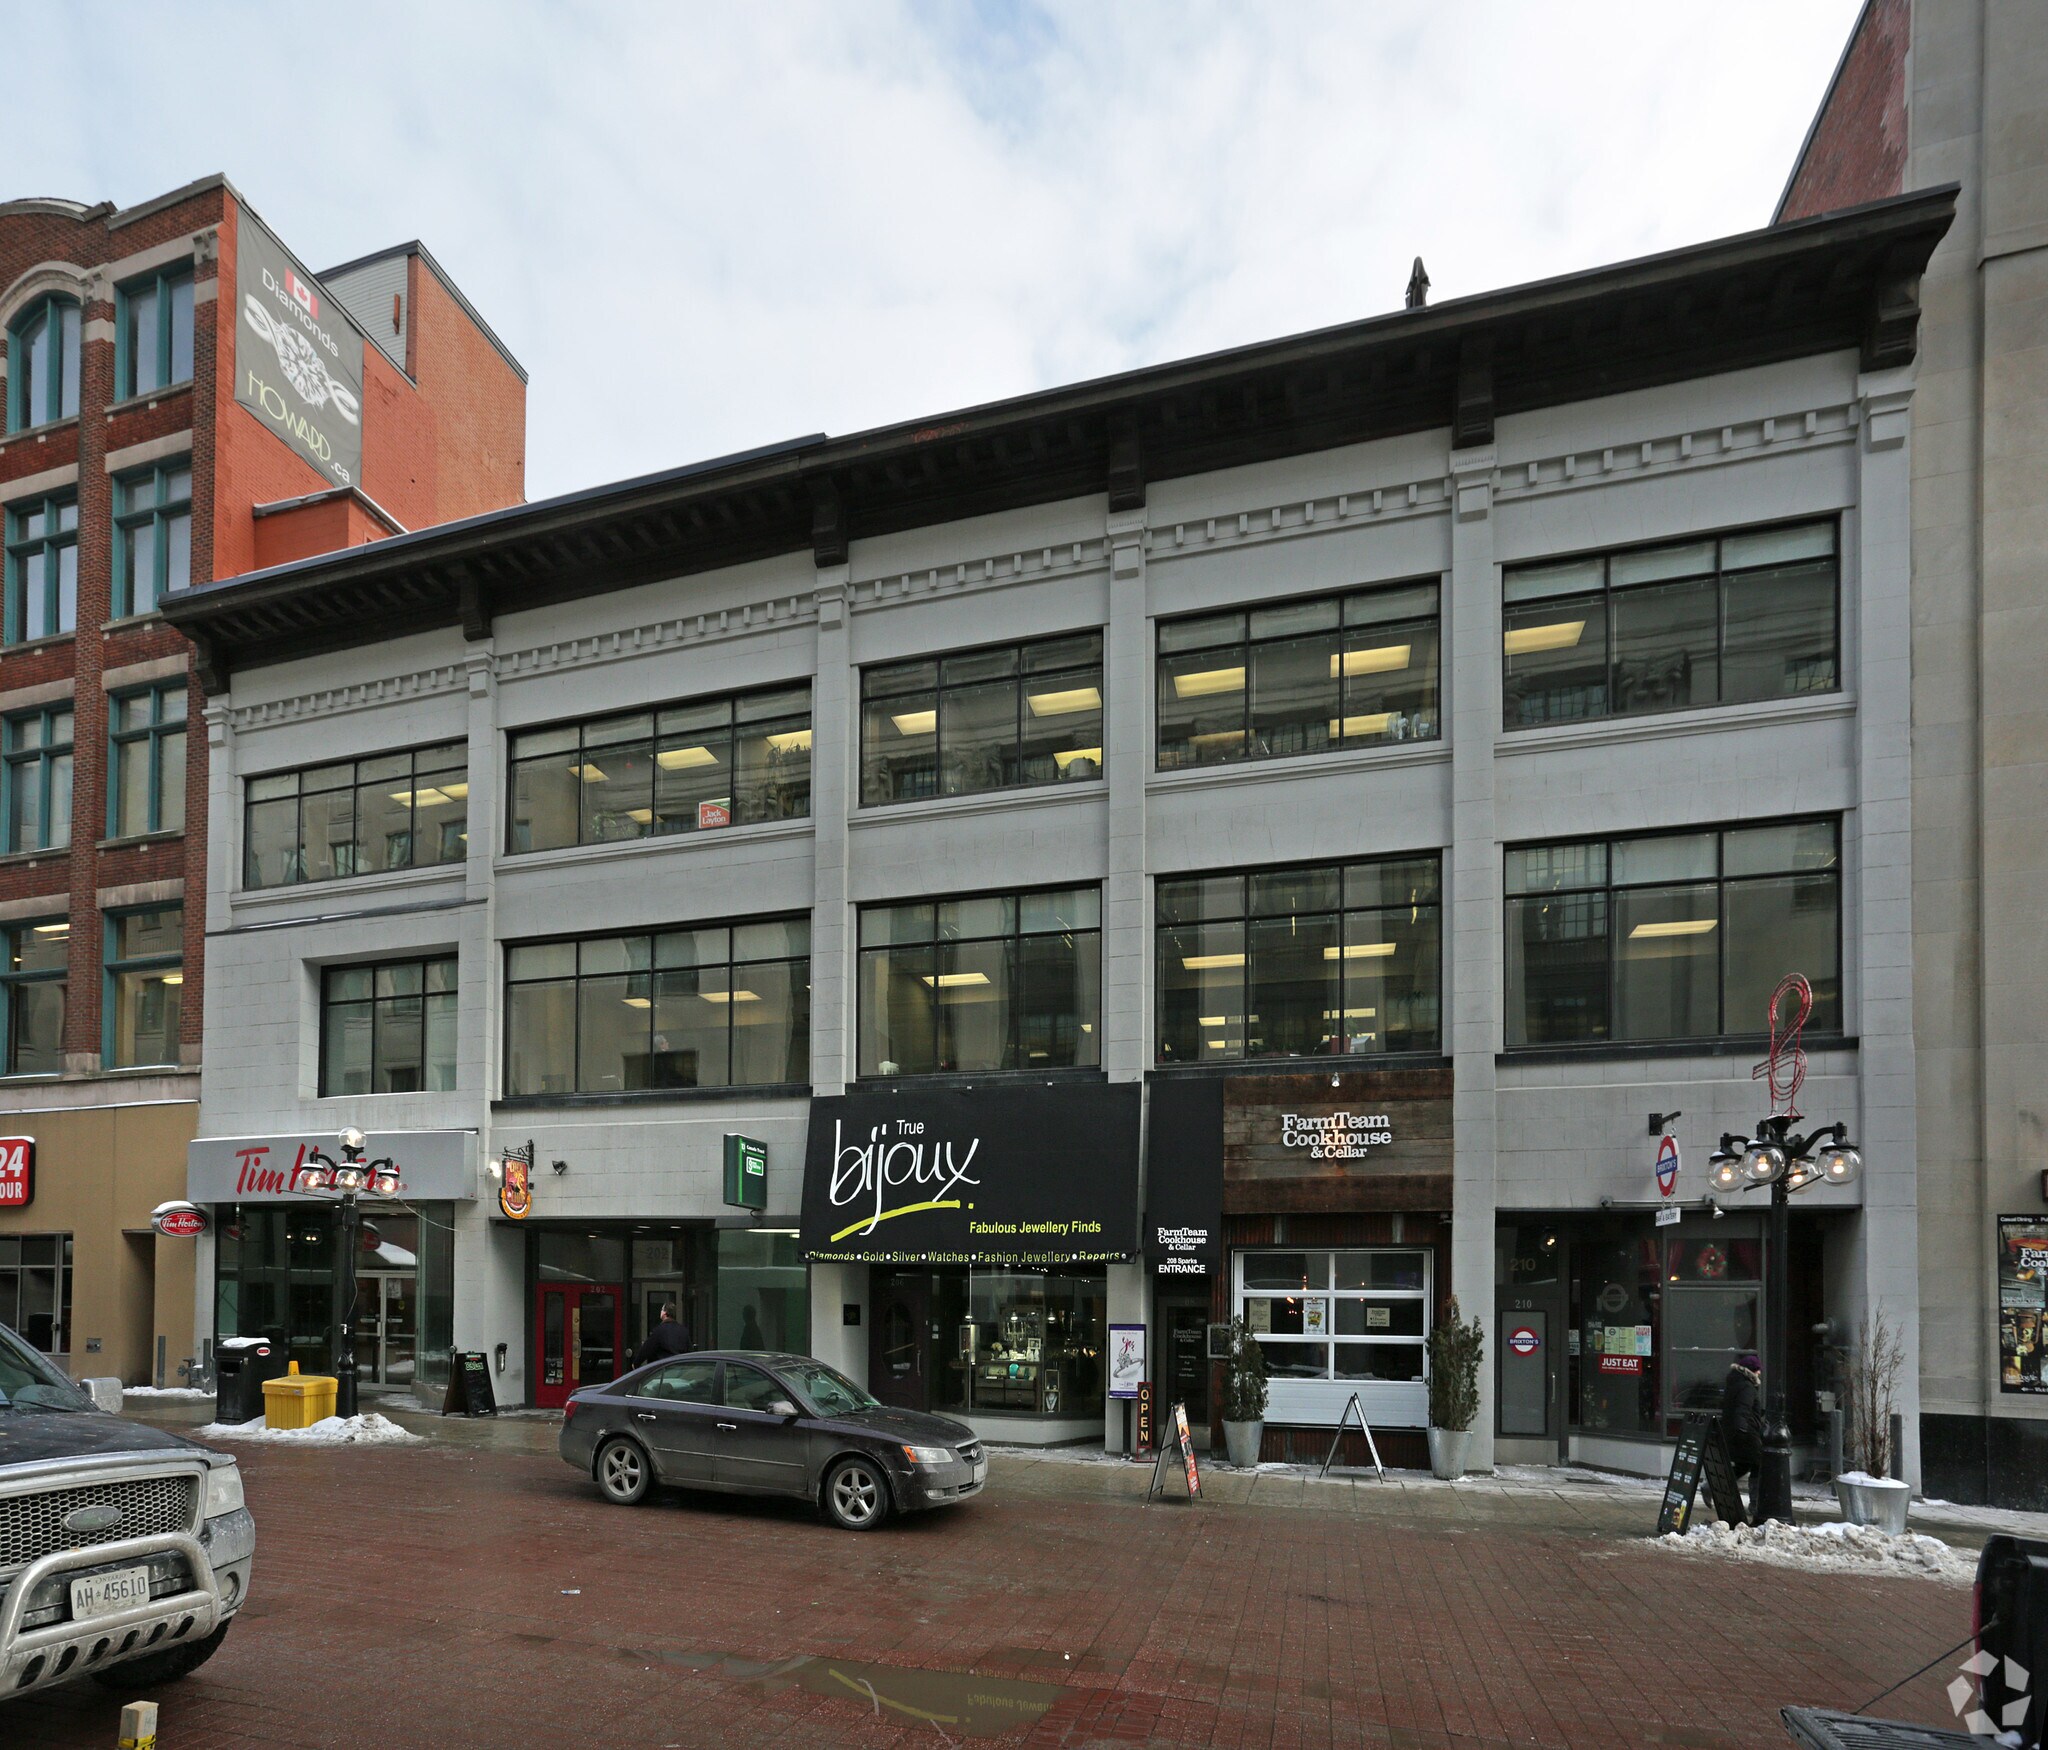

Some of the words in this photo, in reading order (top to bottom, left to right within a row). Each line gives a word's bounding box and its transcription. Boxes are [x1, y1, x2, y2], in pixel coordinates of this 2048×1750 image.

[262, 267, 339, 358] Diamonds
[706, 809, 722, 819] Jack
[702, 816, 727, 825] Layton
[896, 1120, 925, 1135] True
[1281, 1112, 1391, 1131] FarmTeam
[1282, 1129, 1392, 1147] Cookhouse
[1324, 1145, 1368, 1159] Cellar
[236, 1147, 285, 1195] Tim
[829, 1119, 981, 1236] bijoux
[969, 1221, 1017, 1234] Fabulous
[1019, 1221, 1069, 1236] Jewellery
[1071, 1220, 1102, 1233] Finds
[1157, 1227, 1208, 1236] FarmTeam
[1158, 1235, 1207, 1244] Cookhouse
[1175, 1243, 1197, 1251] Cellar
[862, 1251, 885, 1262] Gold
[892, 1251, 921, 1262] Silver
[927, 1251, 970, 1263] Watches
[977, 1251, 1018, 1263] Fashion
[1021, 1251, 1071, 1263] Jewellery
[1079, 1250, 1121, 1262] Repairs
[1177, 1257, 1198, 1265] Sparks
[1158, 1264, 1206, 1274] ENTRANCE
[1509, 1258, 1537, 1272] 210
[590, 1285, 606, 1294] 202
[1515, 1299, 1533, 1309] 210
[1508, 1338, 1539, 1346] BRIXTON'S
[1601, 1357, 1621, 1368] JUST
[1622, 1358, 1639, 1368] EAT
[1139, 1388, 1150, 1442] OPEN
[95, 1574, 127, 1585] ONTARIO
[76, 1586, 94, 1609] AH
[103, 1575, 146, 1602] 45610
